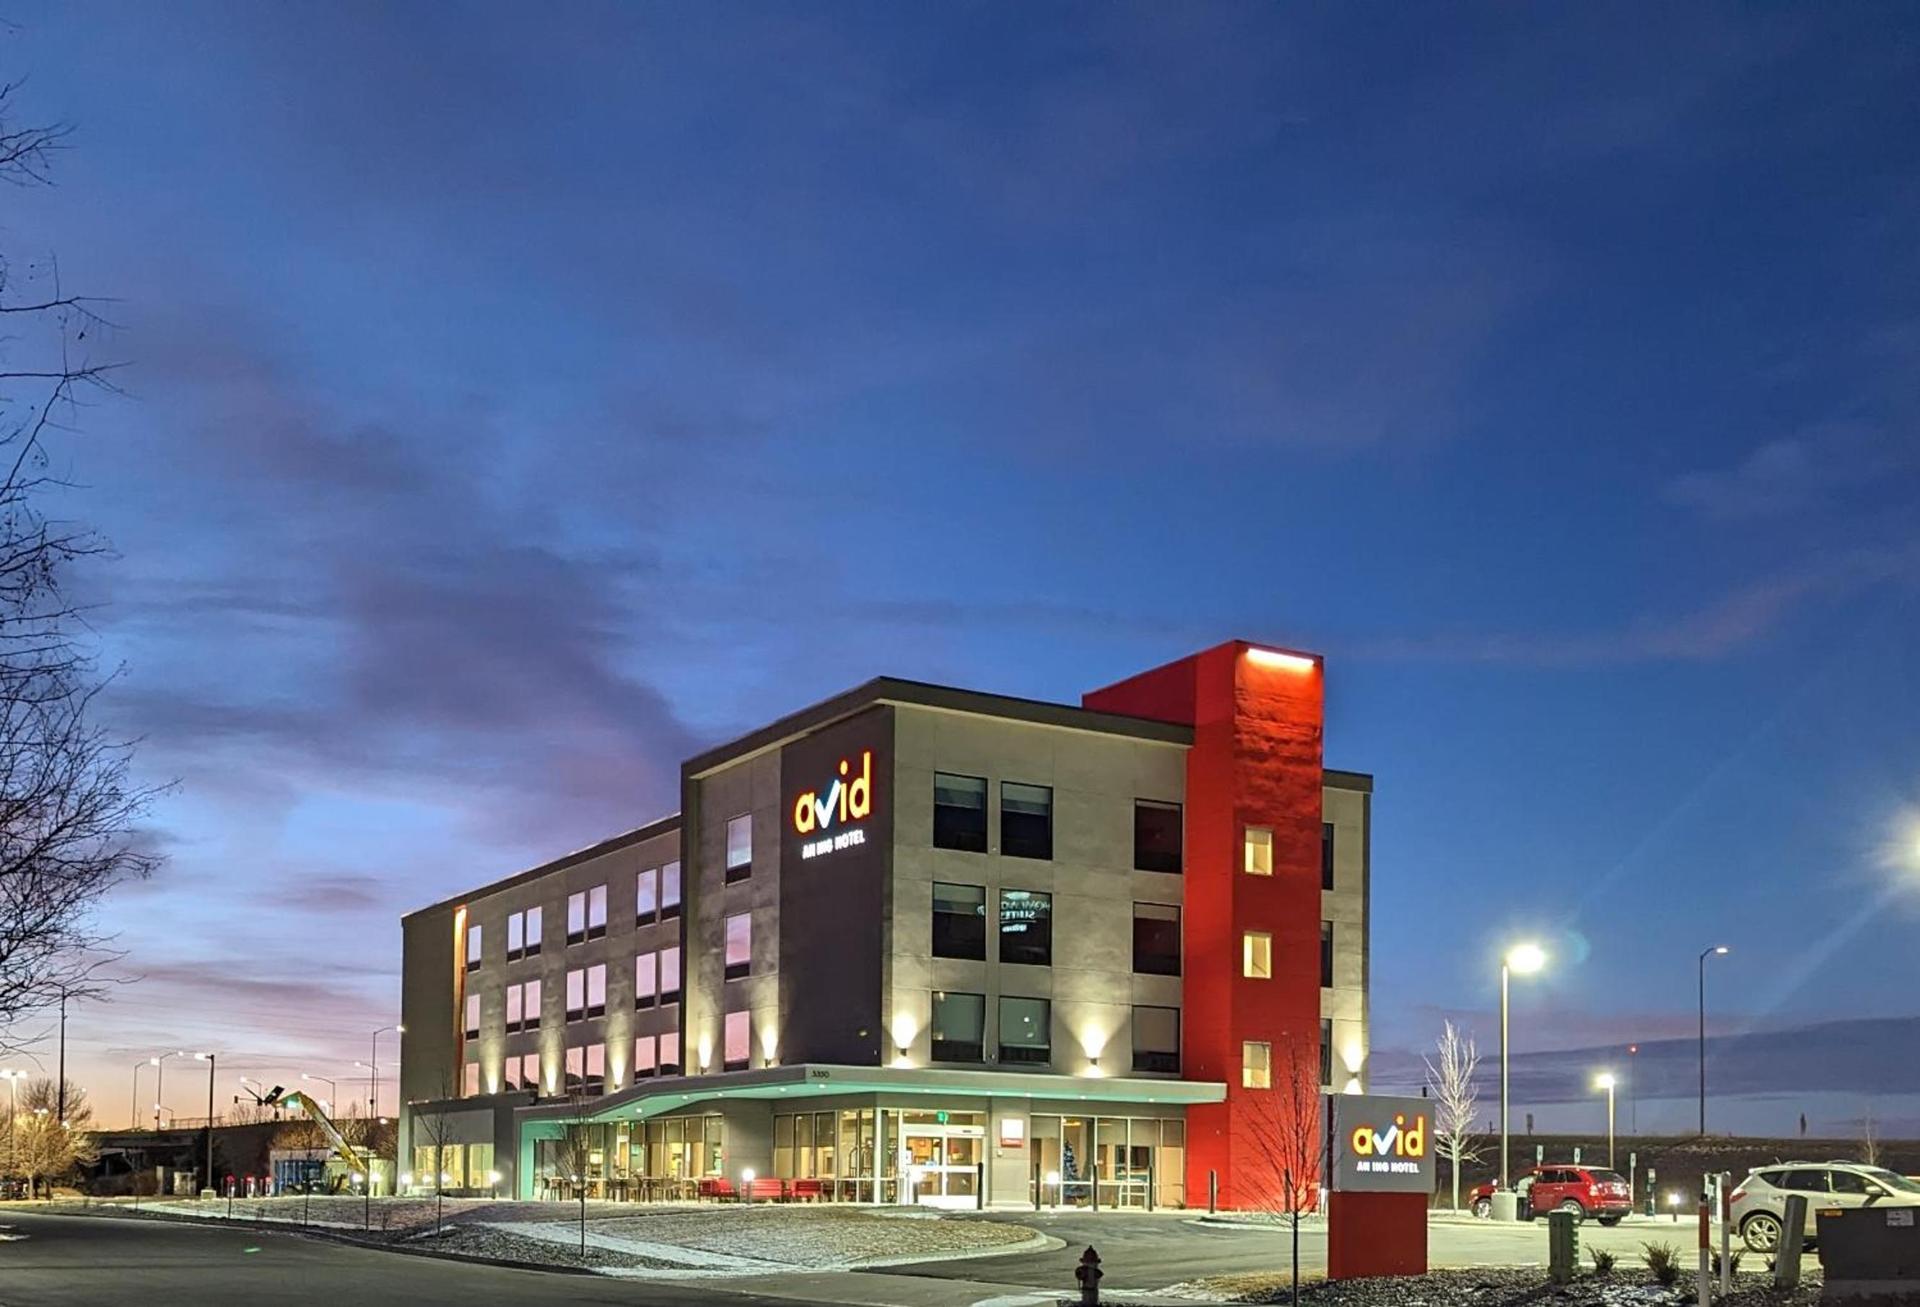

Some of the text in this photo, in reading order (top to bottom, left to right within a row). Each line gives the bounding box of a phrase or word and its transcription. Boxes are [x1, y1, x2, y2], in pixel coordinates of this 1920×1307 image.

[795, 751, 871, 833] avid
[835, 829, 865, 850] HOTEL
[1352, 1115, 1425, 1157] avid
[1356, 1160, 1371, 1172] AN
[1390, 1162, 1420, 1174] HOTEL
